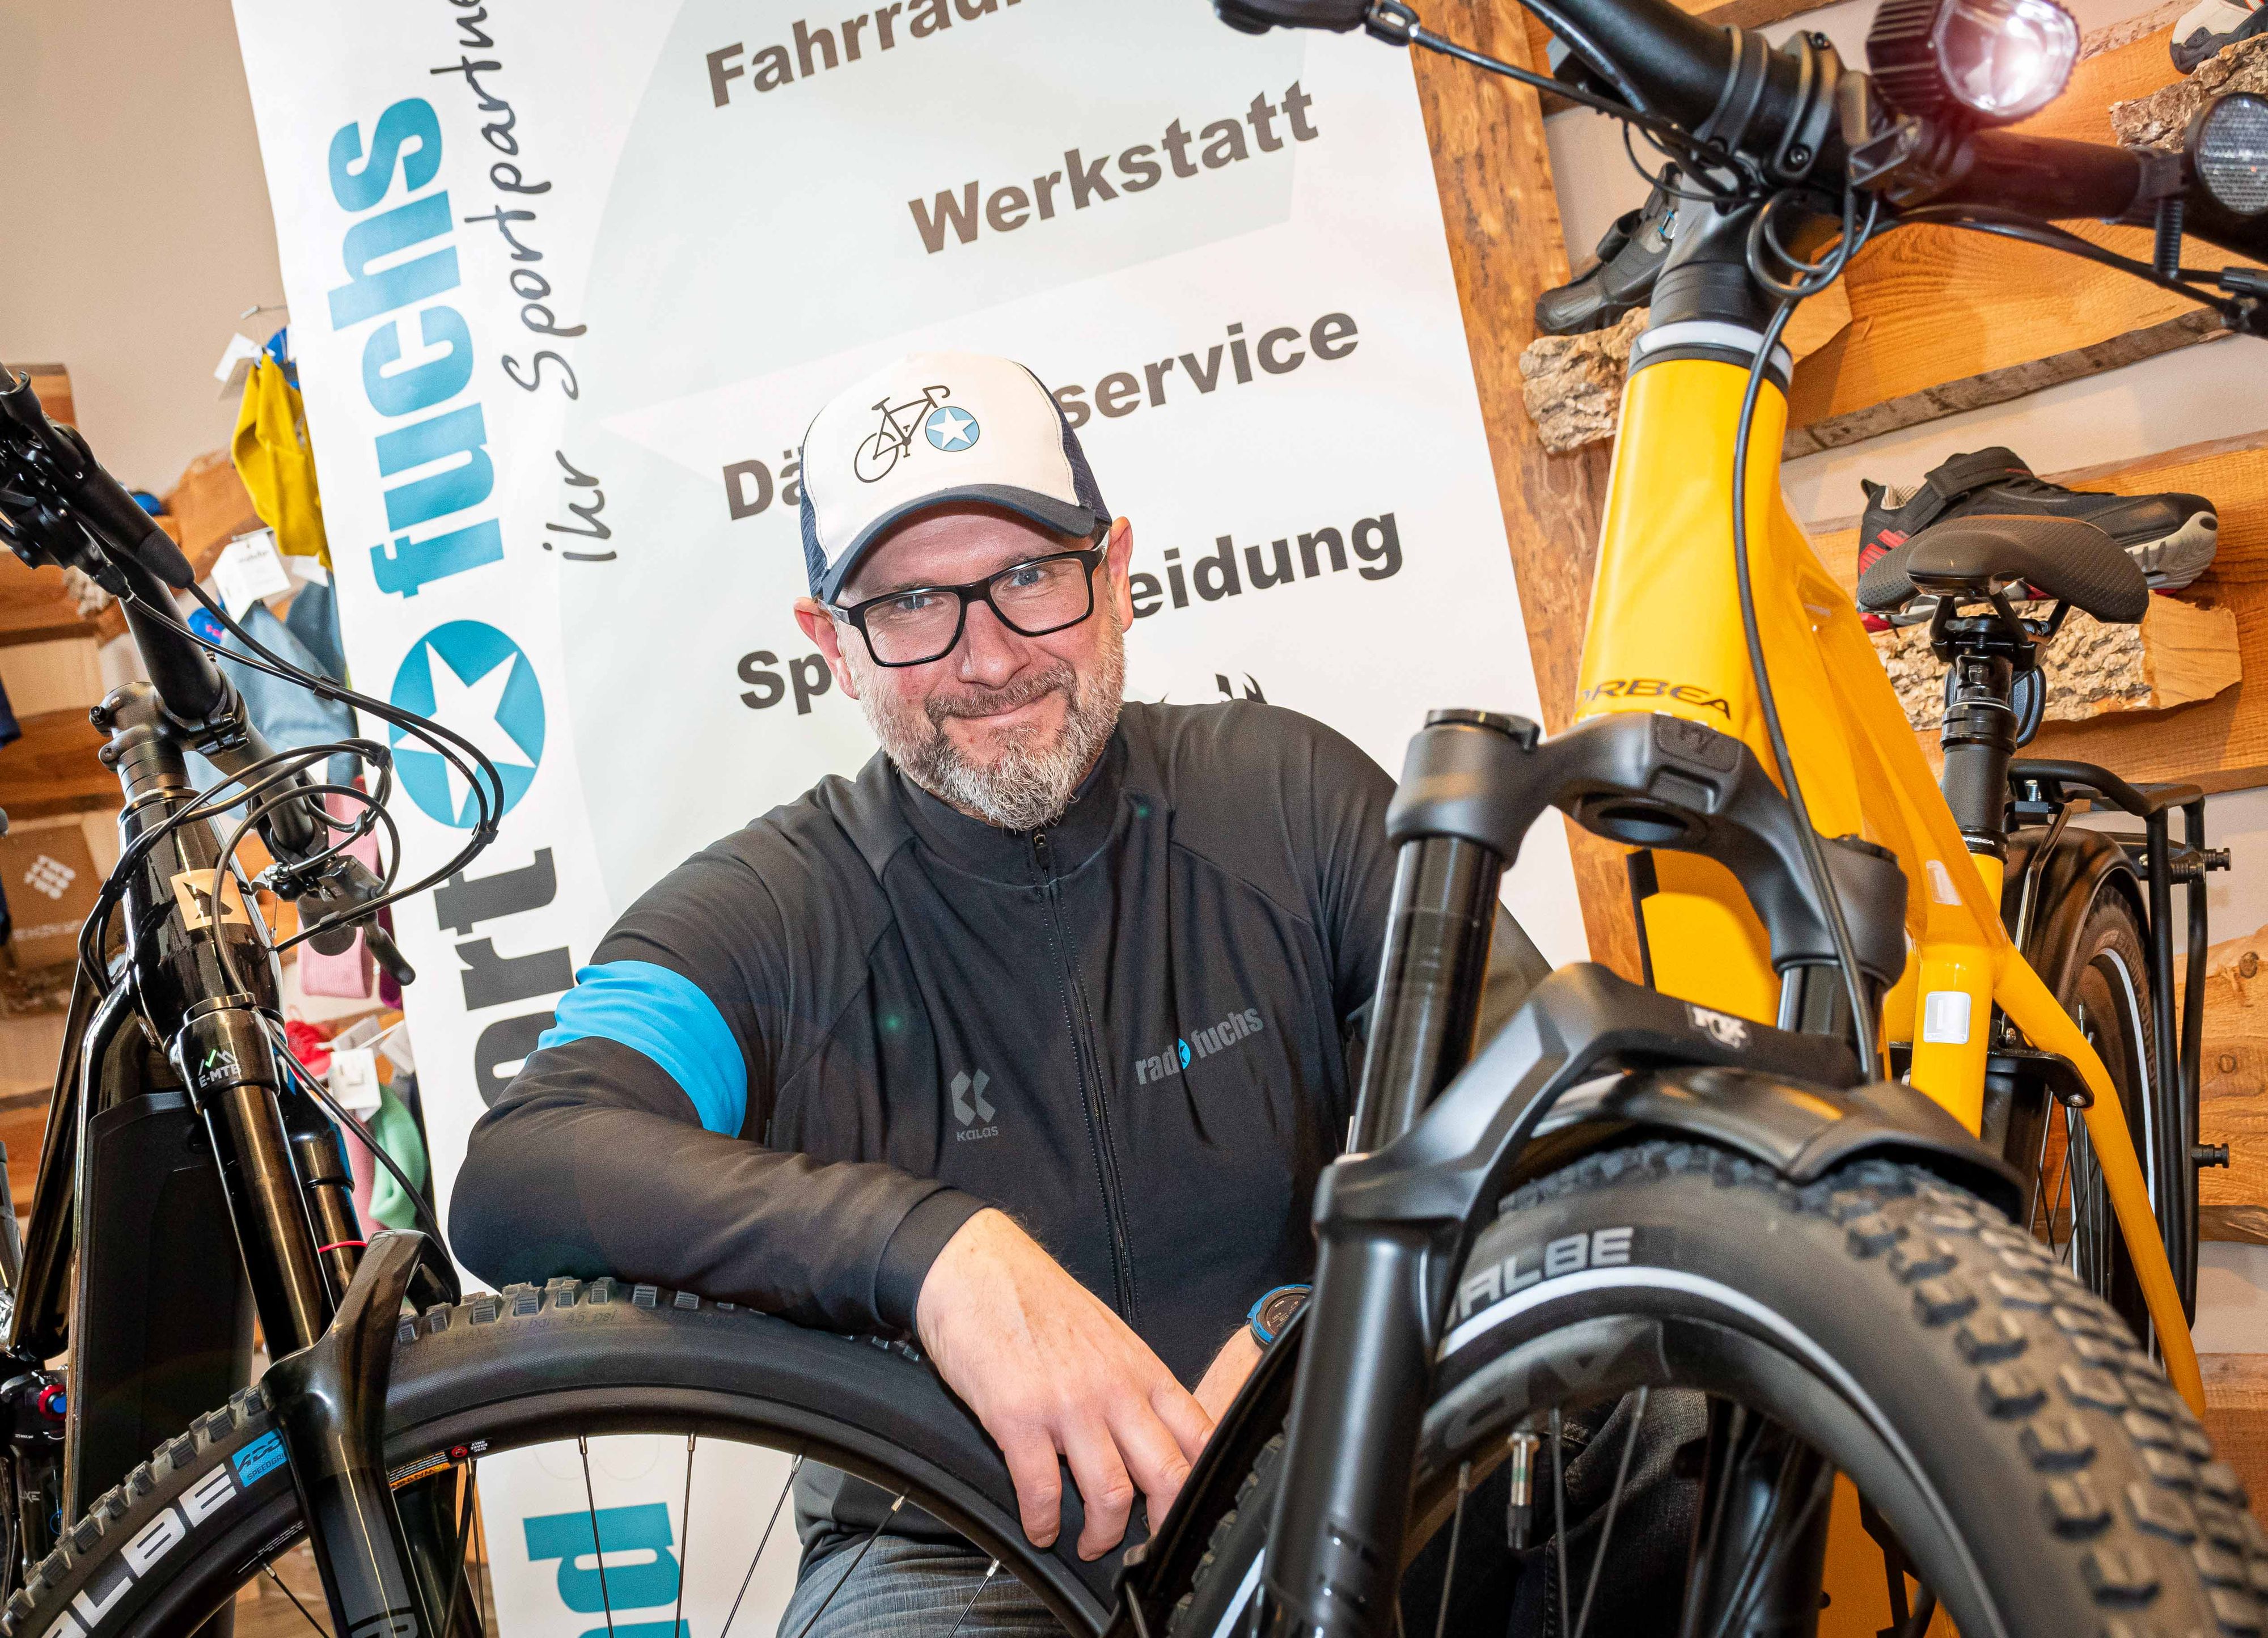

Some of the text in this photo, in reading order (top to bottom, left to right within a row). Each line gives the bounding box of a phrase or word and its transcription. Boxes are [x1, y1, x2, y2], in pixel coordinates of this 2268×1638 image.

[705, 0, 1021, 108] Fahrra
[430, 0, 587, 400] Sportpartn
[909, 79, 1319, 255] Werkstatt
[327, 97, 505, 599] fuchs
[198, 1063, 242, 1088] E-MTB
[1135, 1008, 1264, 1085] rad fuchs
